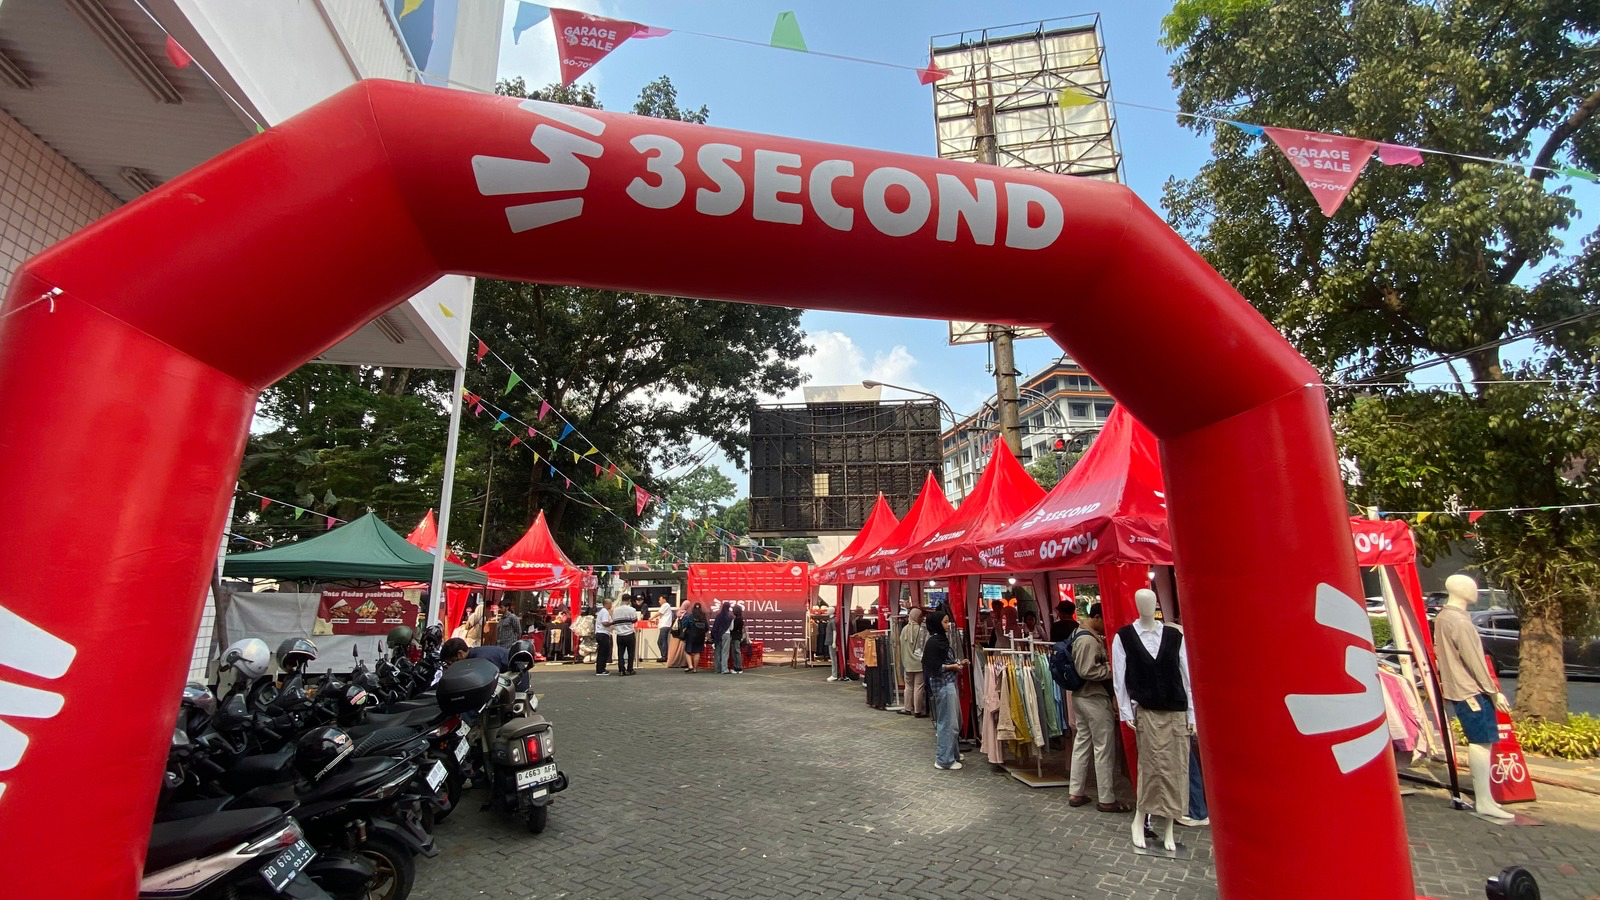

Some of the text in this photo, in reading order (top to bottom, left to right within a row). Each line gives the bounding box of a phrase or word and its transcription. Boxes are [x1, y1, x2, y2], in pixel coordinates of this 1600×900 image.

[564, 26, 617, 40] GARAGE
[581, 36, 614, 51] SALE
[1287, 146, 1350, 160] GARAGE
[1314, 160, 1352, 173] SALE
[626, 134, 1064, 251] 3SECOND
[1041, 502, 1101, 522] 3SECOND
[1040, 532, 1098, 560] 60-70%
[1352, 532, 1392, 553] 0%
[979, 544, 1004, 559] GARAGE
[1014, 549, 1035, 558] DISCOUNT
[988, 557, 1005, 567] SALE
[518, 773, 523, 781] D
[264, 866, 277, 879] DD
[276, 849, 295, 868] 6761
